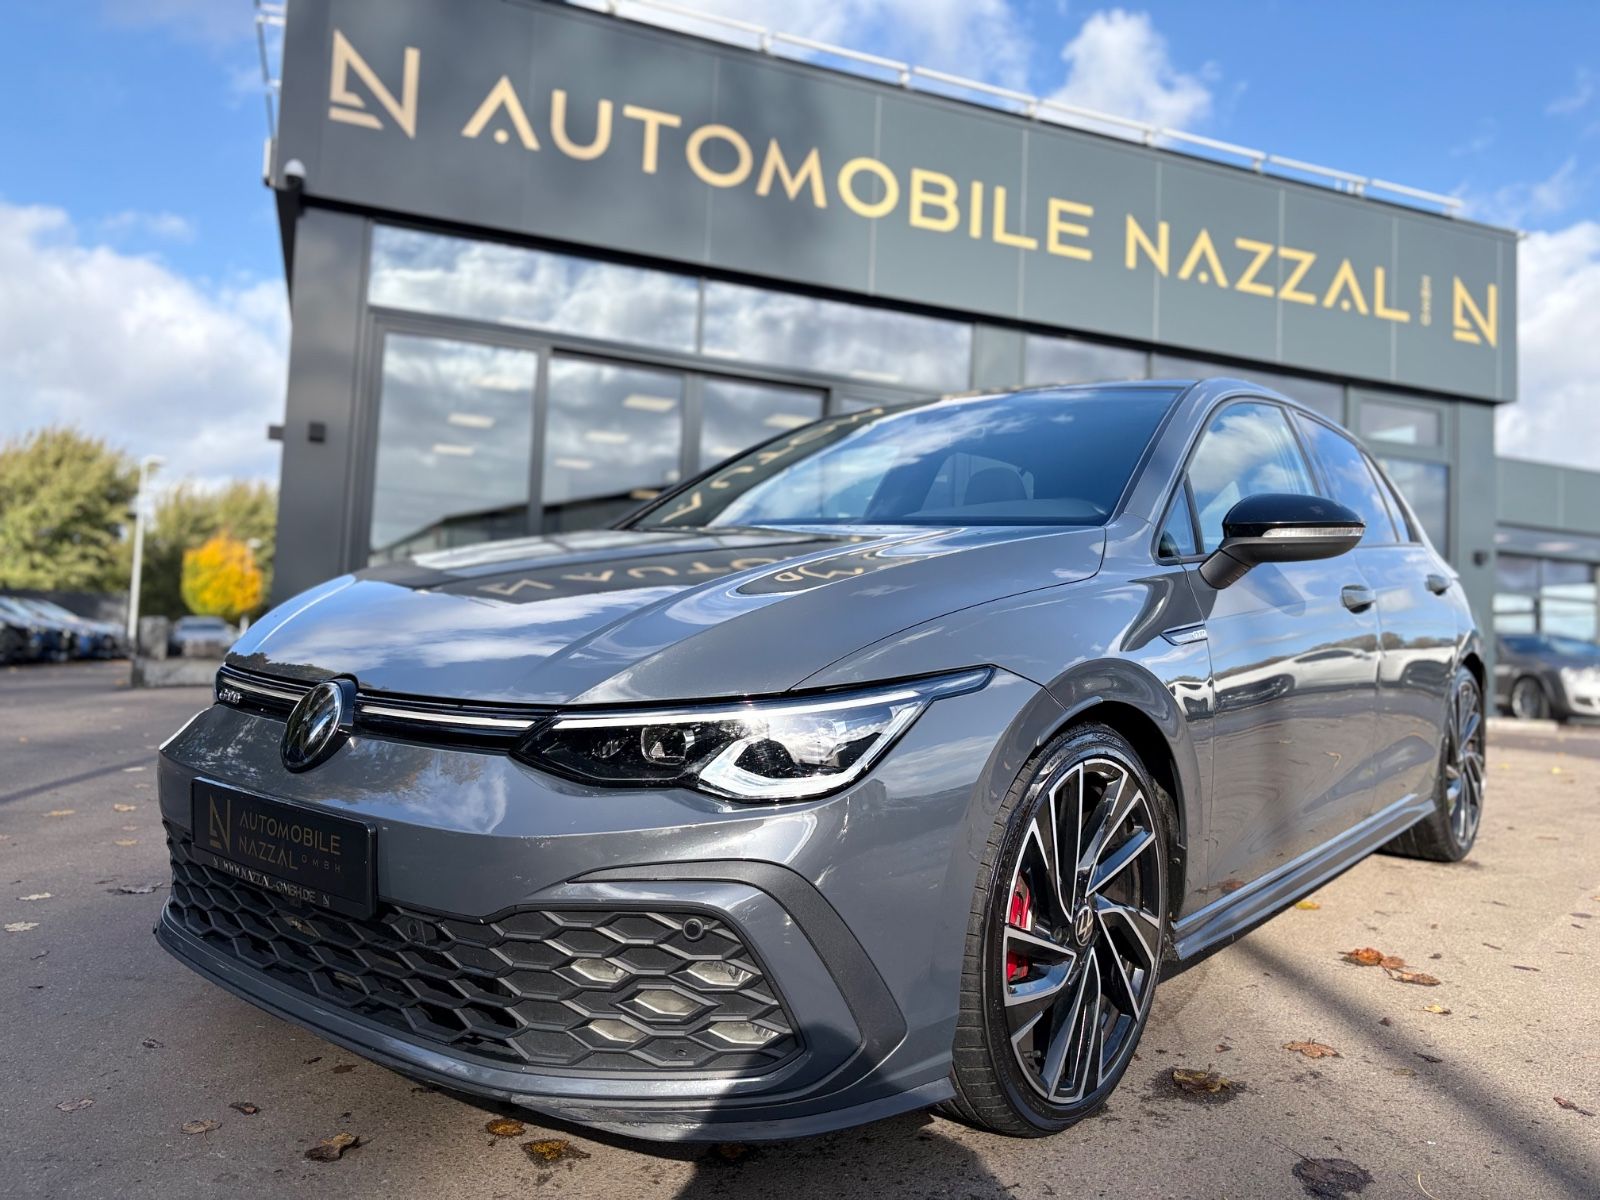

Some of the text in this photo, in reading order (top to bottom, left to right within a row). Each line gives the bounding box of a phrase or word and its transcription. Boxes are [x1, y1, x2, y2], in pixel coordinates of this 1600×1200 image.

[461, 75, 1094, 260] AUTOMOBILE
[1125, 213, 1410, 323] NAZZAL
[238, 837, 299, 871] NAZZAL
[239, 811, 341, 856] AUTOMOBILE
